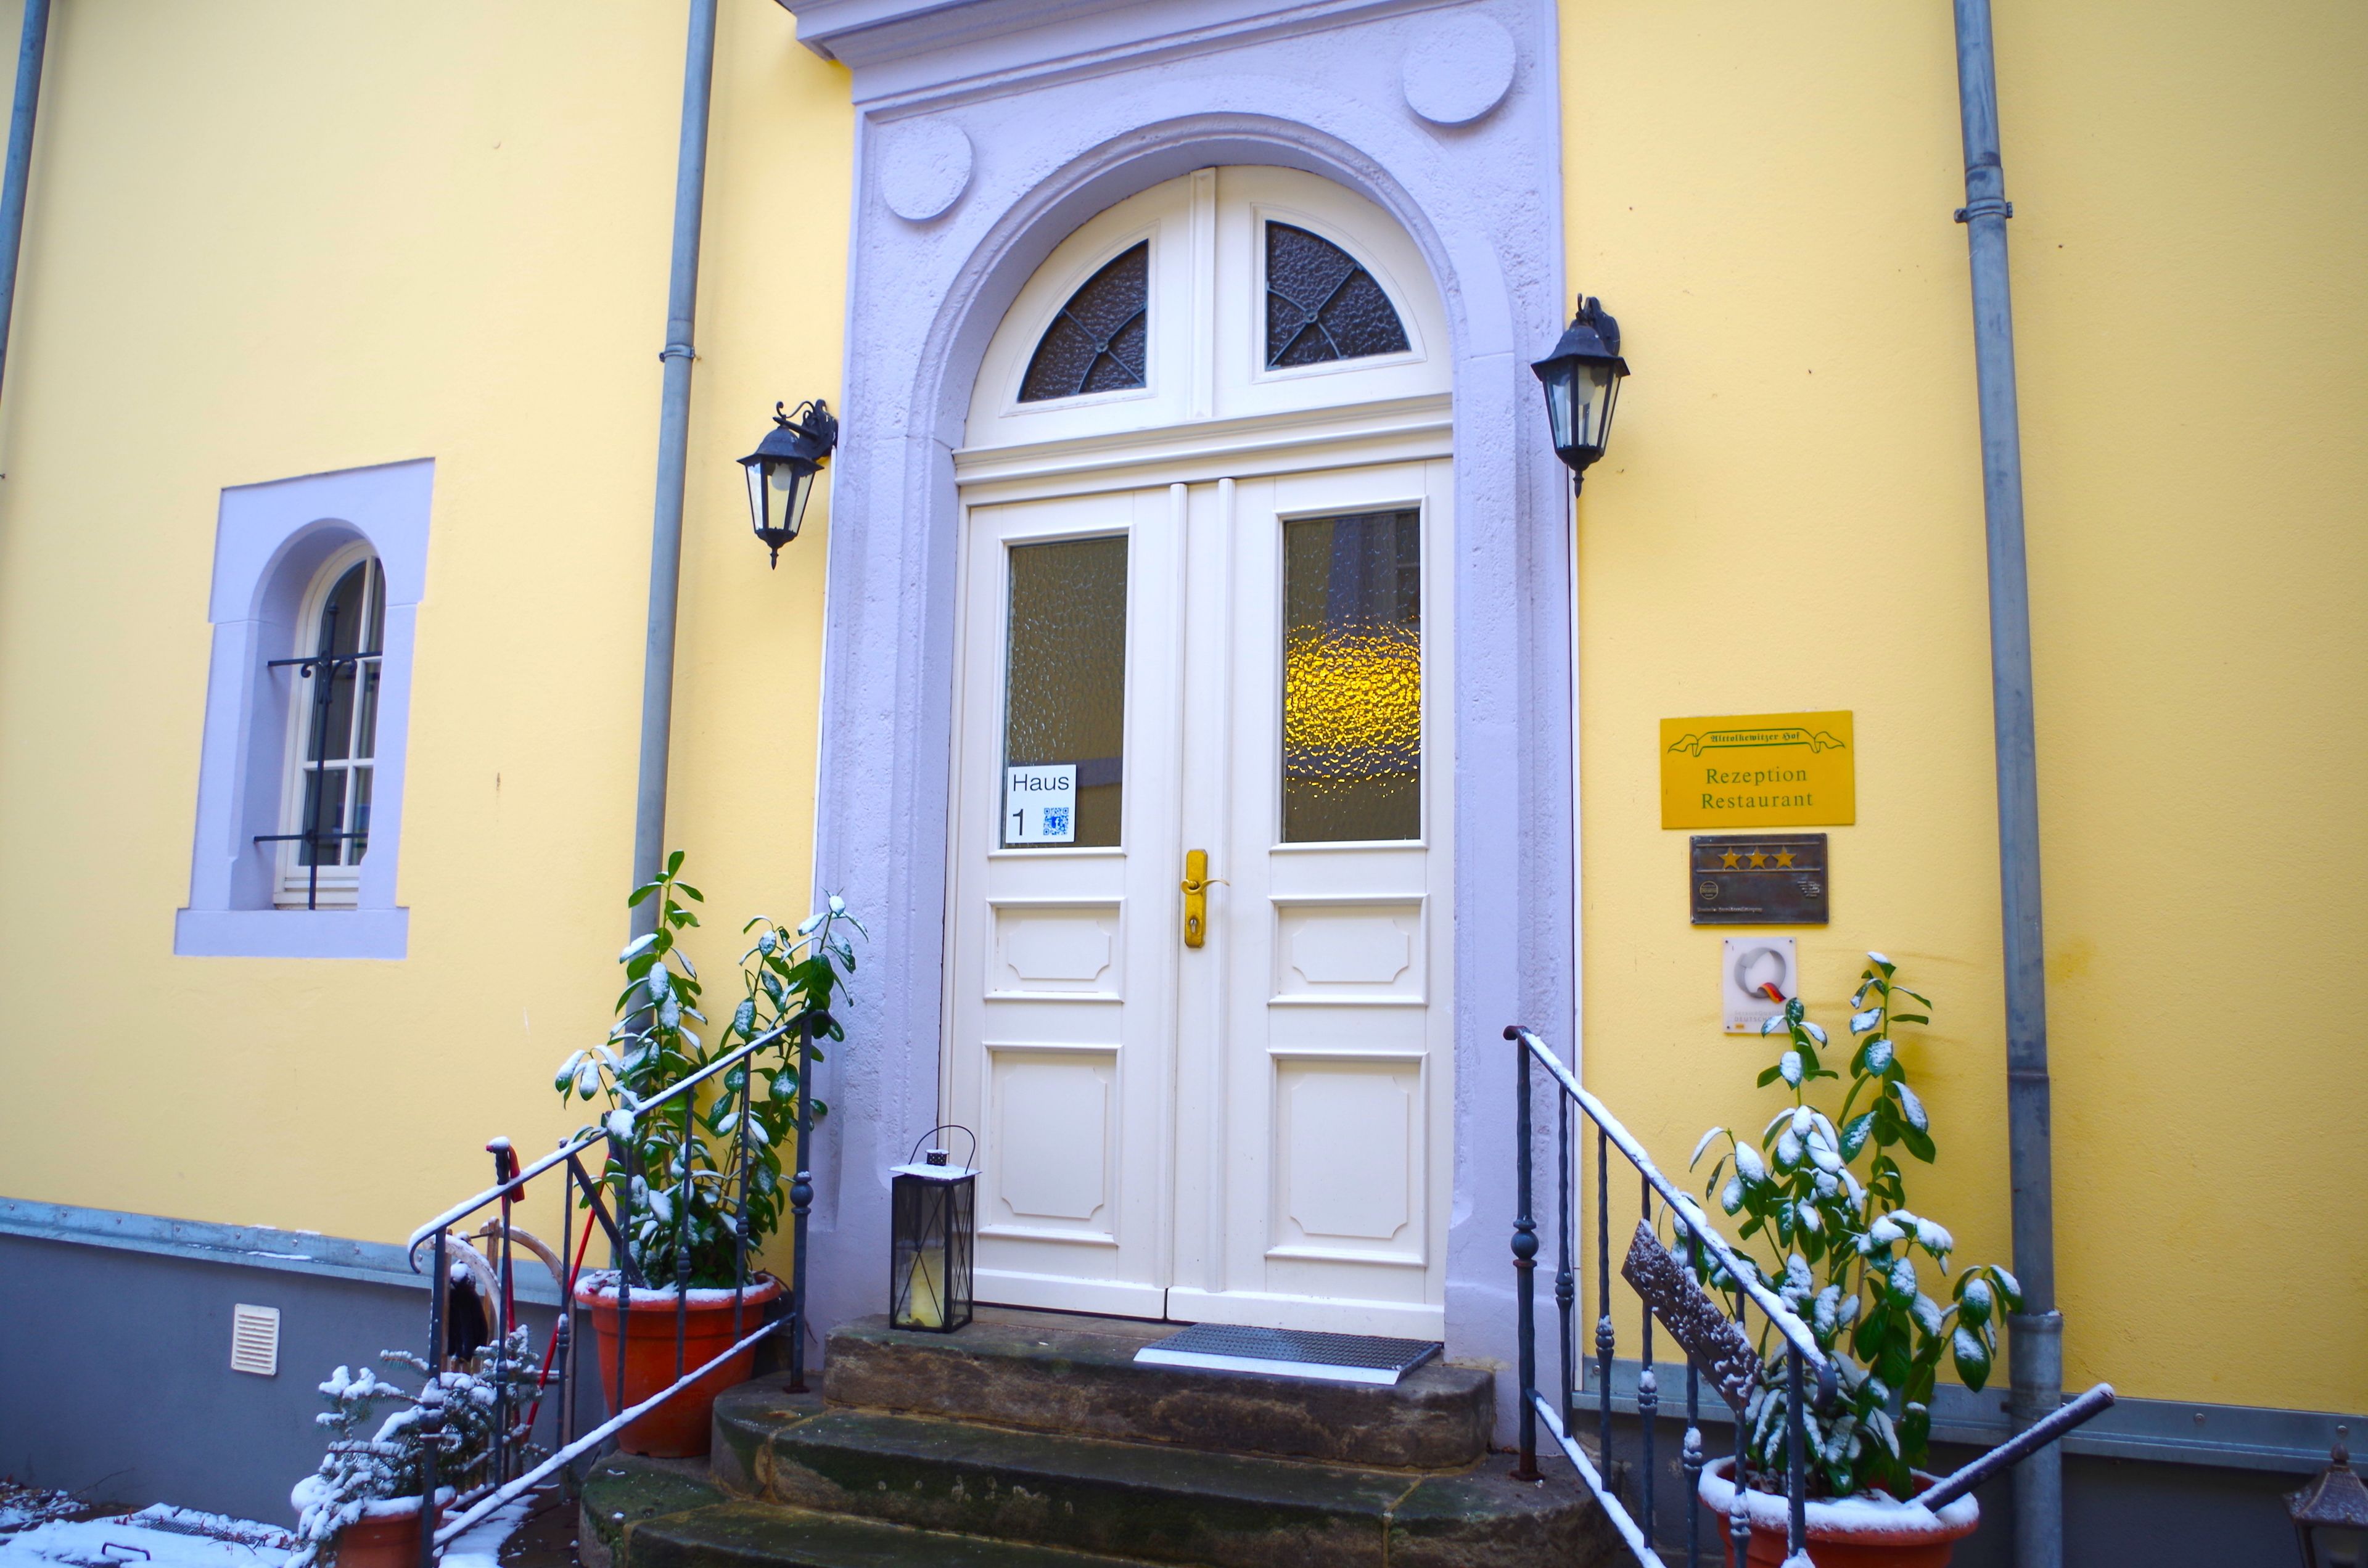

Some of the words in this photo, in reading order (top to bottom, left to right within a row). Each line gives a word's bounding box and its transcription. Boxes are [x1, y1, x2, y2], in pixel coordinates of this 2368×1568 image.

[1782, 731, 1801, 741] Hof
[1013, 774, 1069, 792] Haus
[1706, 766, 1807, 786] Rezeption
[1701, 792, 1814, 810] Restaurant
[1012, 808, 1024, 836] 1
